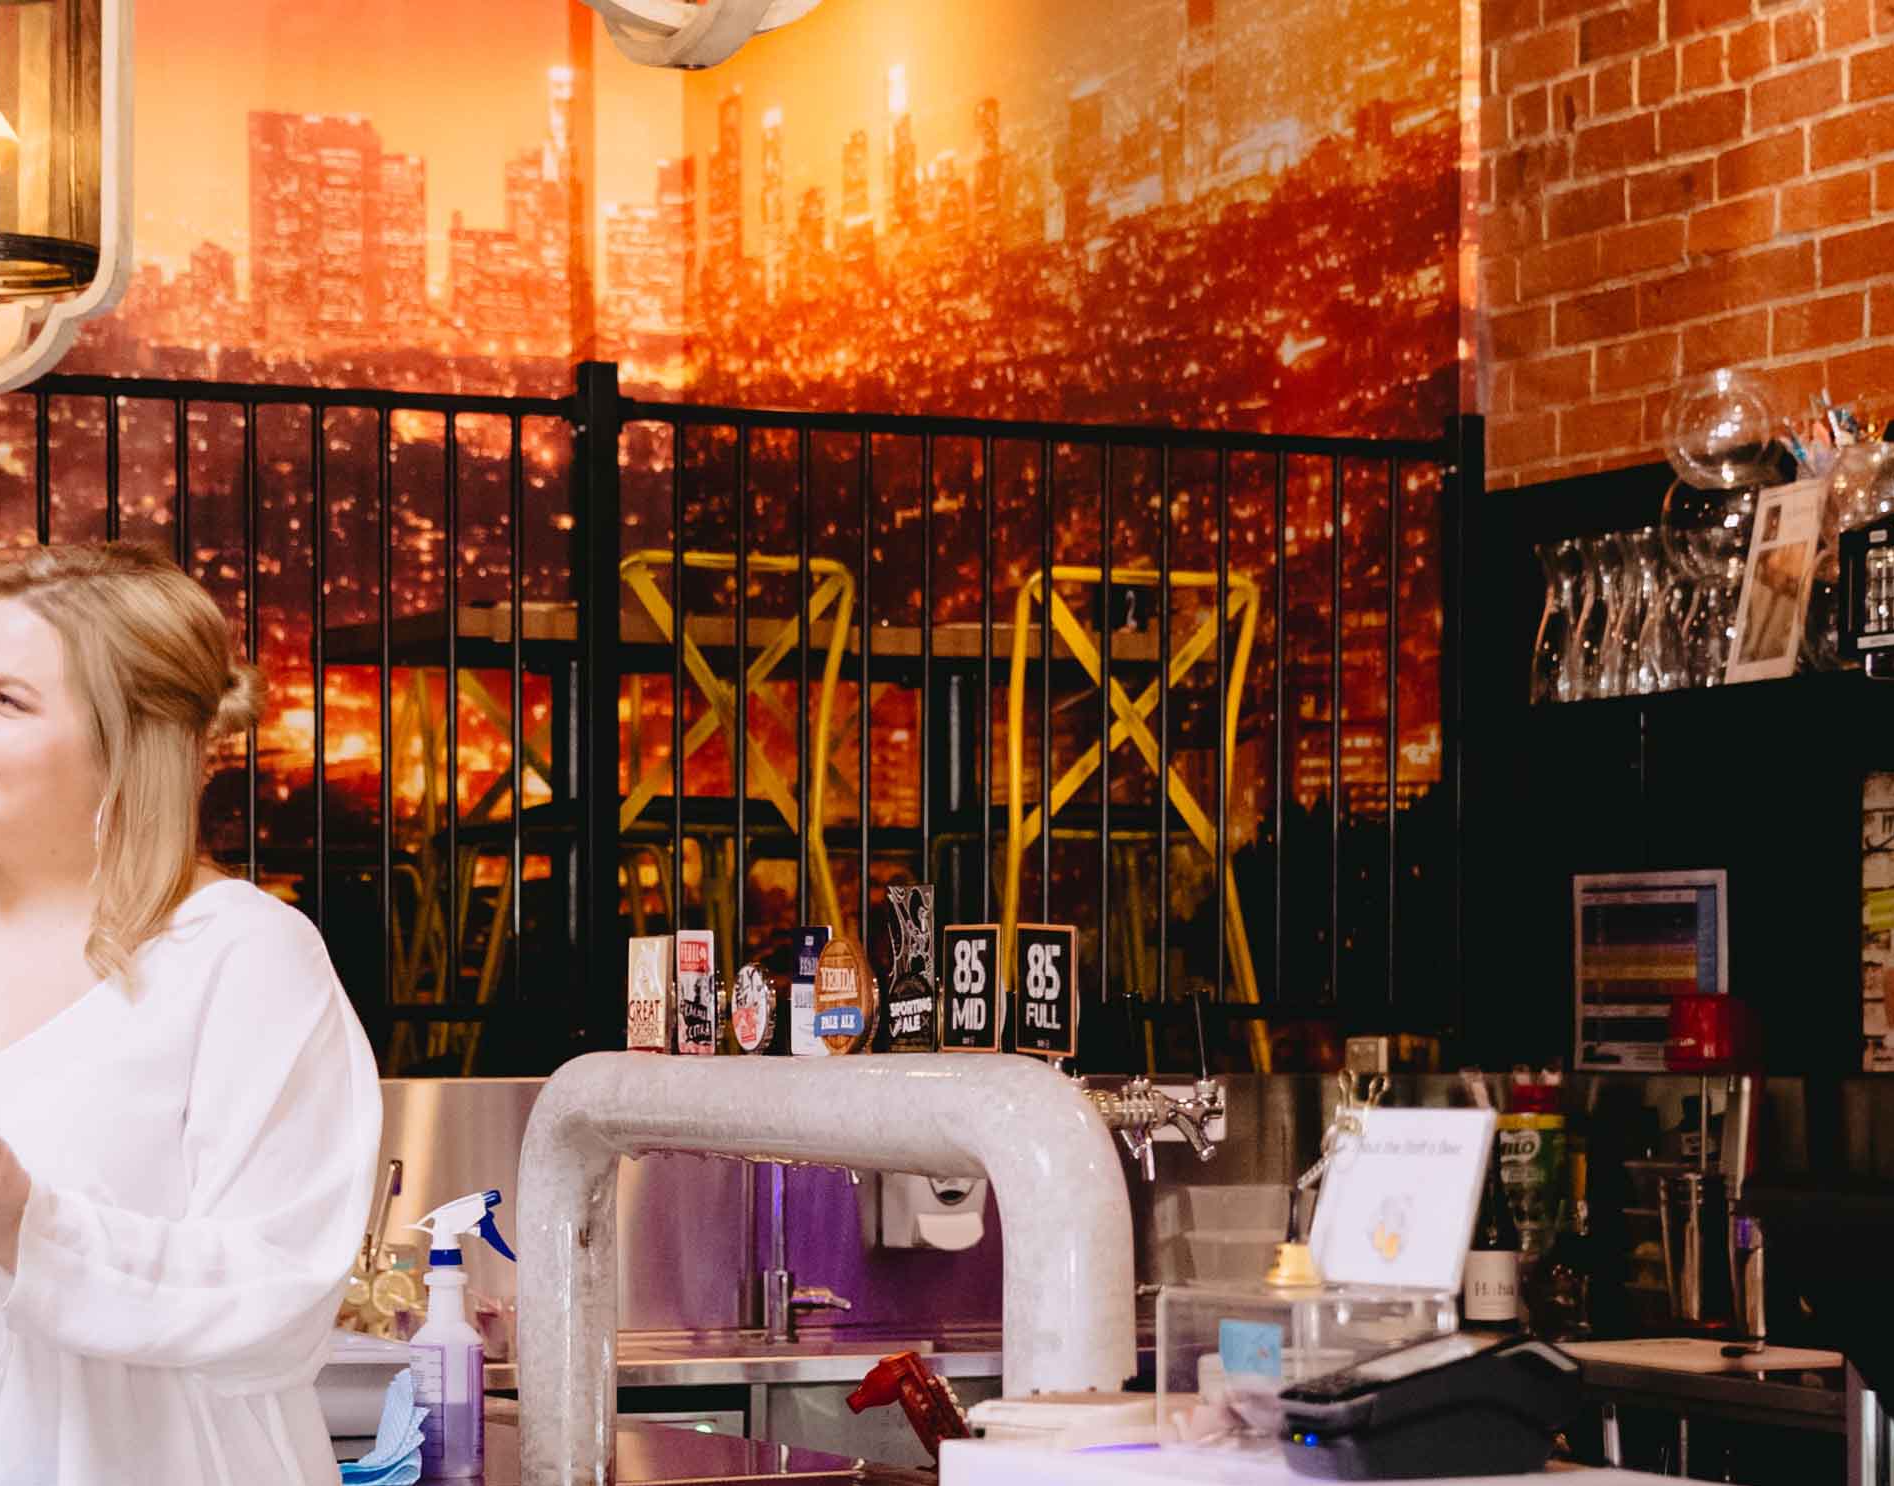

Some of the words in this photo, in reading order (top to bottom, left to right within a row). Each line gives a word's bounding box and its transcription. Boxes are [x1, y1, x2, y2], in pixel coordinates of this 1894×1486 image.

[820, 967, 857, 993] YENDA
[953, 938, 987, 995] 85
[1026, 943, 1061, 1001] 85
[629, 1000, 661, 1023] GREAT
[889, 996, 933, 1018] SPORTING
[952, 997, 987, 1031] MID
[1026, 1002, 1062, 1030] FULL
[902, 1013, 921, 1033] ALE
